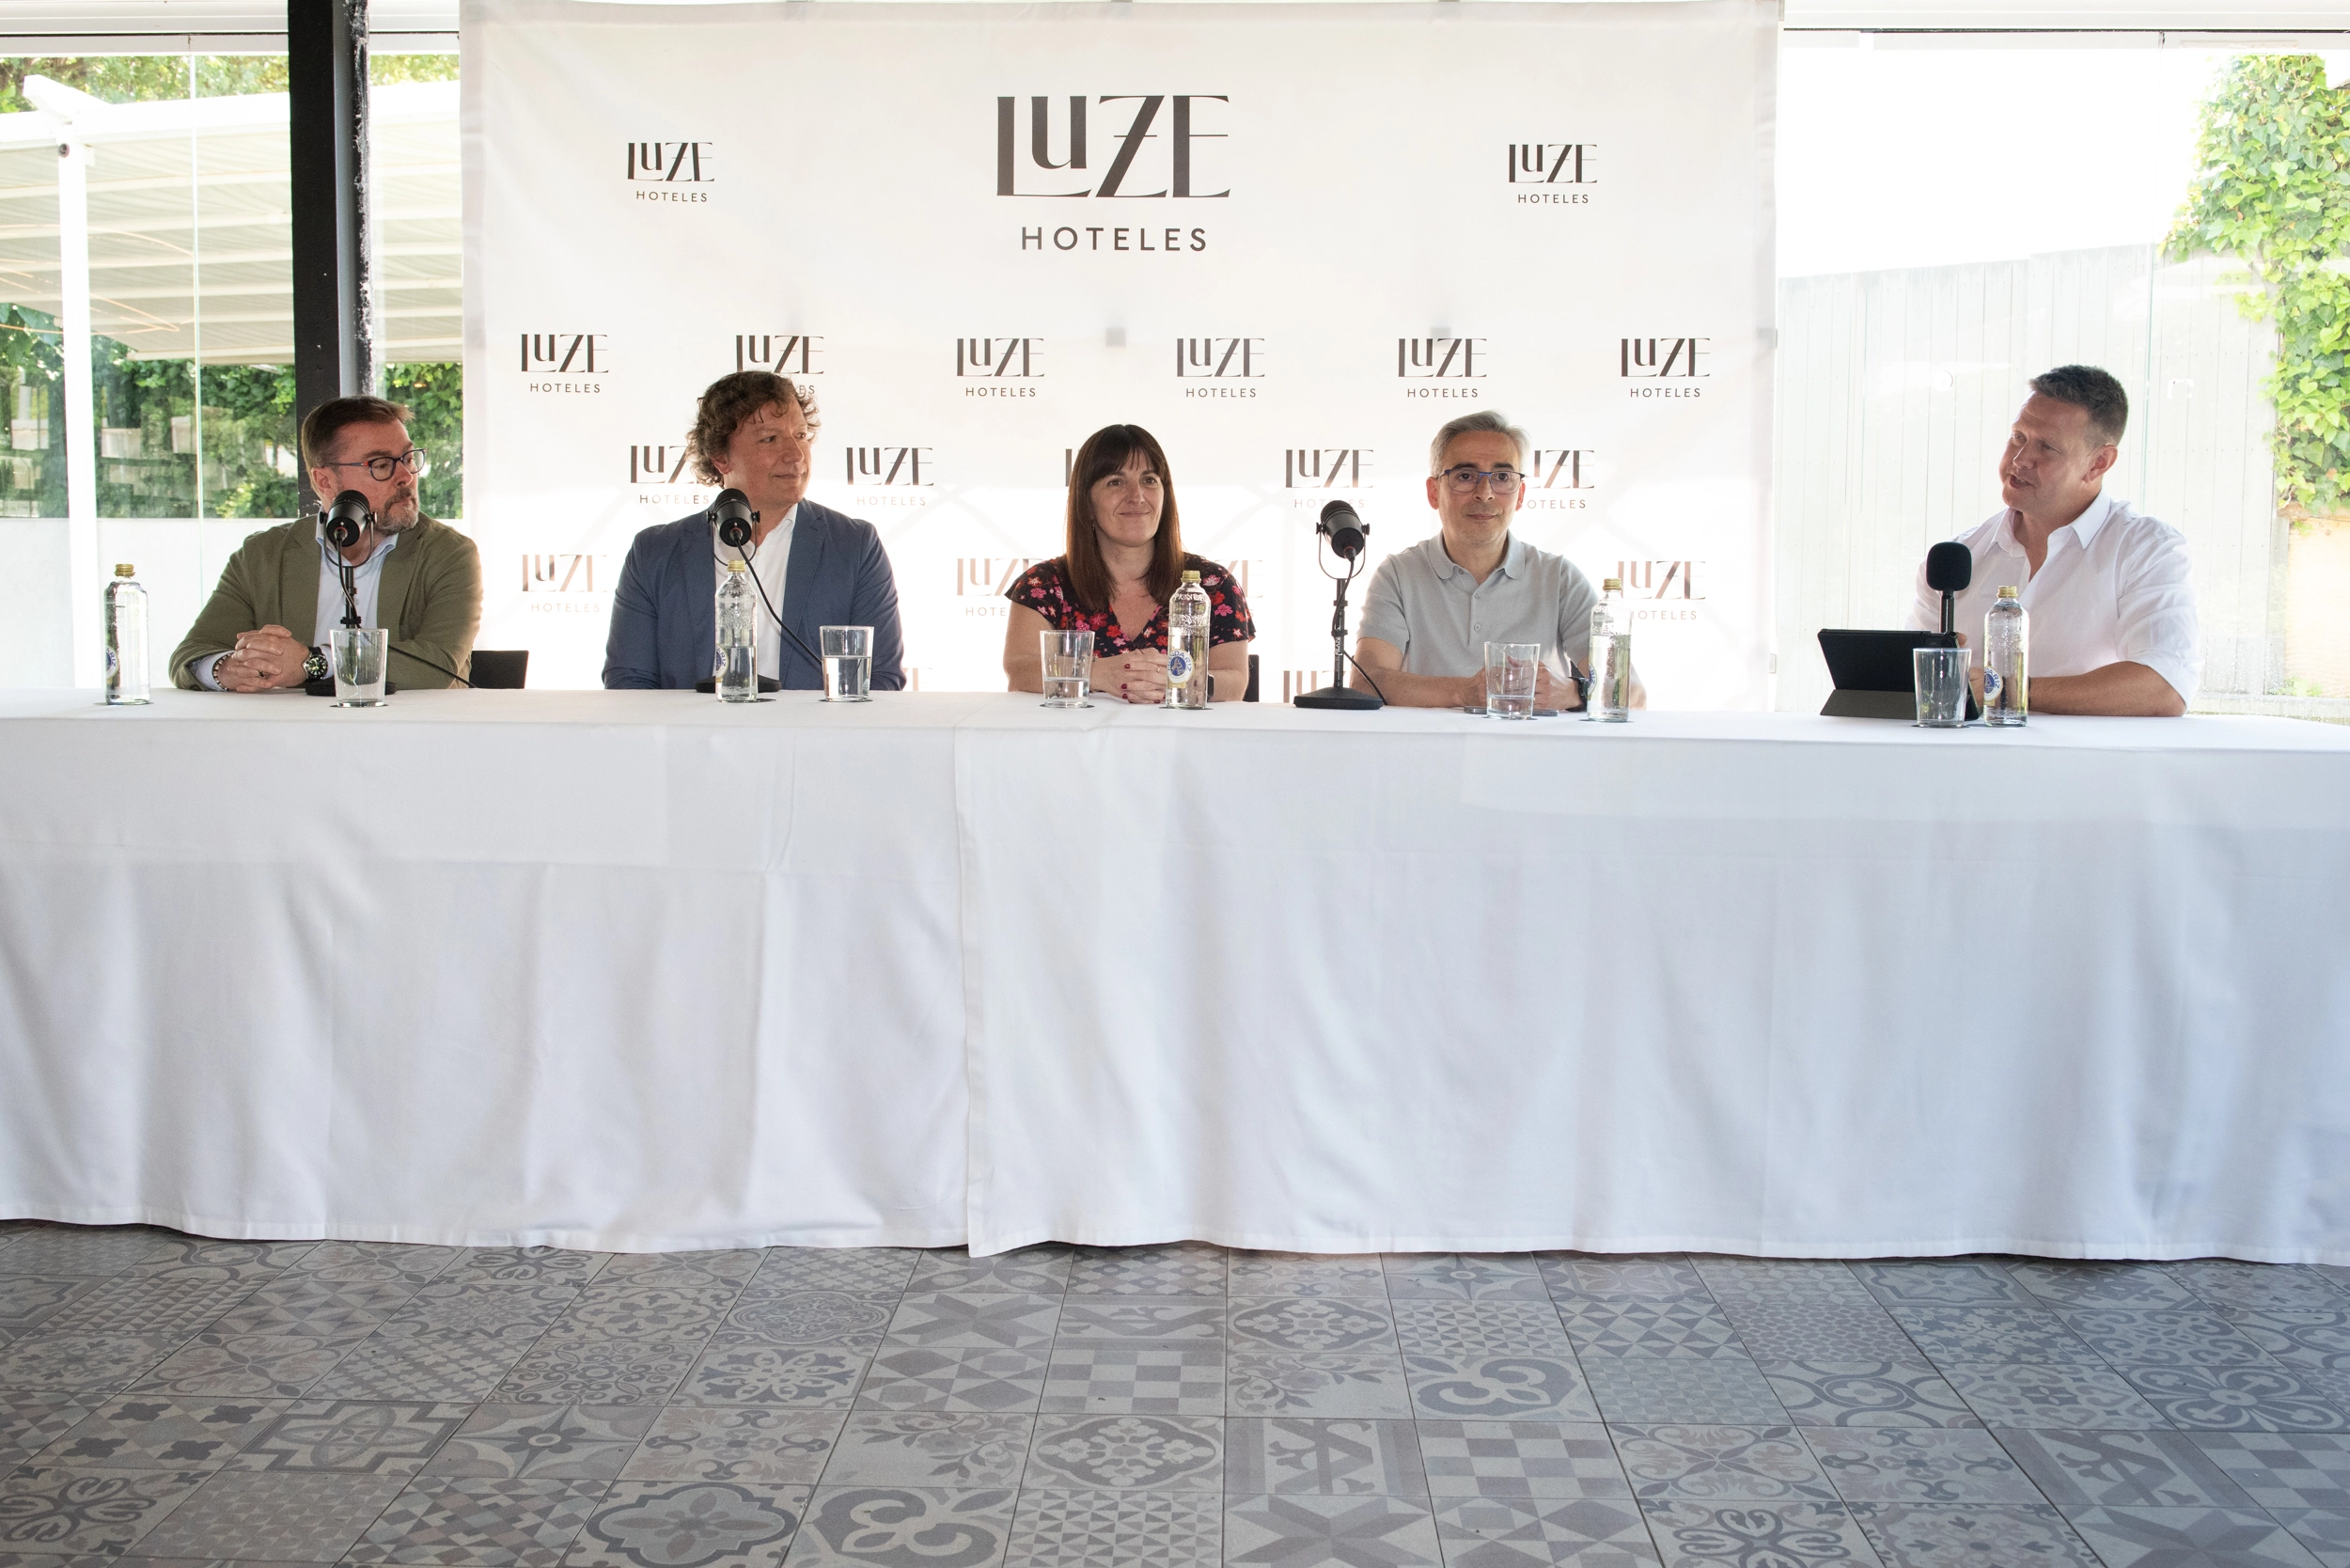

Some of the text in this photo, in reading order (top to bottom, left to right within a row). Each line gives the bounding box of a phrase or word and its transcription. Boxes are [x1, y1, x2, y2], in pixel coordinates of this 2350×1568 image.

[636, 191, 707, 202] HOTELES
[1518, 194, 1589, 204] HOTELES
[1022, 227, 1206, 252] HOTELES
[530, 384, 600, 393] HOTELES
[965, 387, 1036, 398] HOTELES
[1185, 388, 1256, 399] HOTELES
[1407, 388, 1478, 399] HOTELES
[1630, 388, 1700, 398] HOTELES
[639, 494, 709, 505] HOTELES
[856, 496, 926, 506] HOTELES
[1293, 498, 1365, 509] HOTES
[1527, 499, 1586, 510] OTELES
[531, 604, 600, 613] HOTELES
[965, 606, 1007, 617] HOTE
